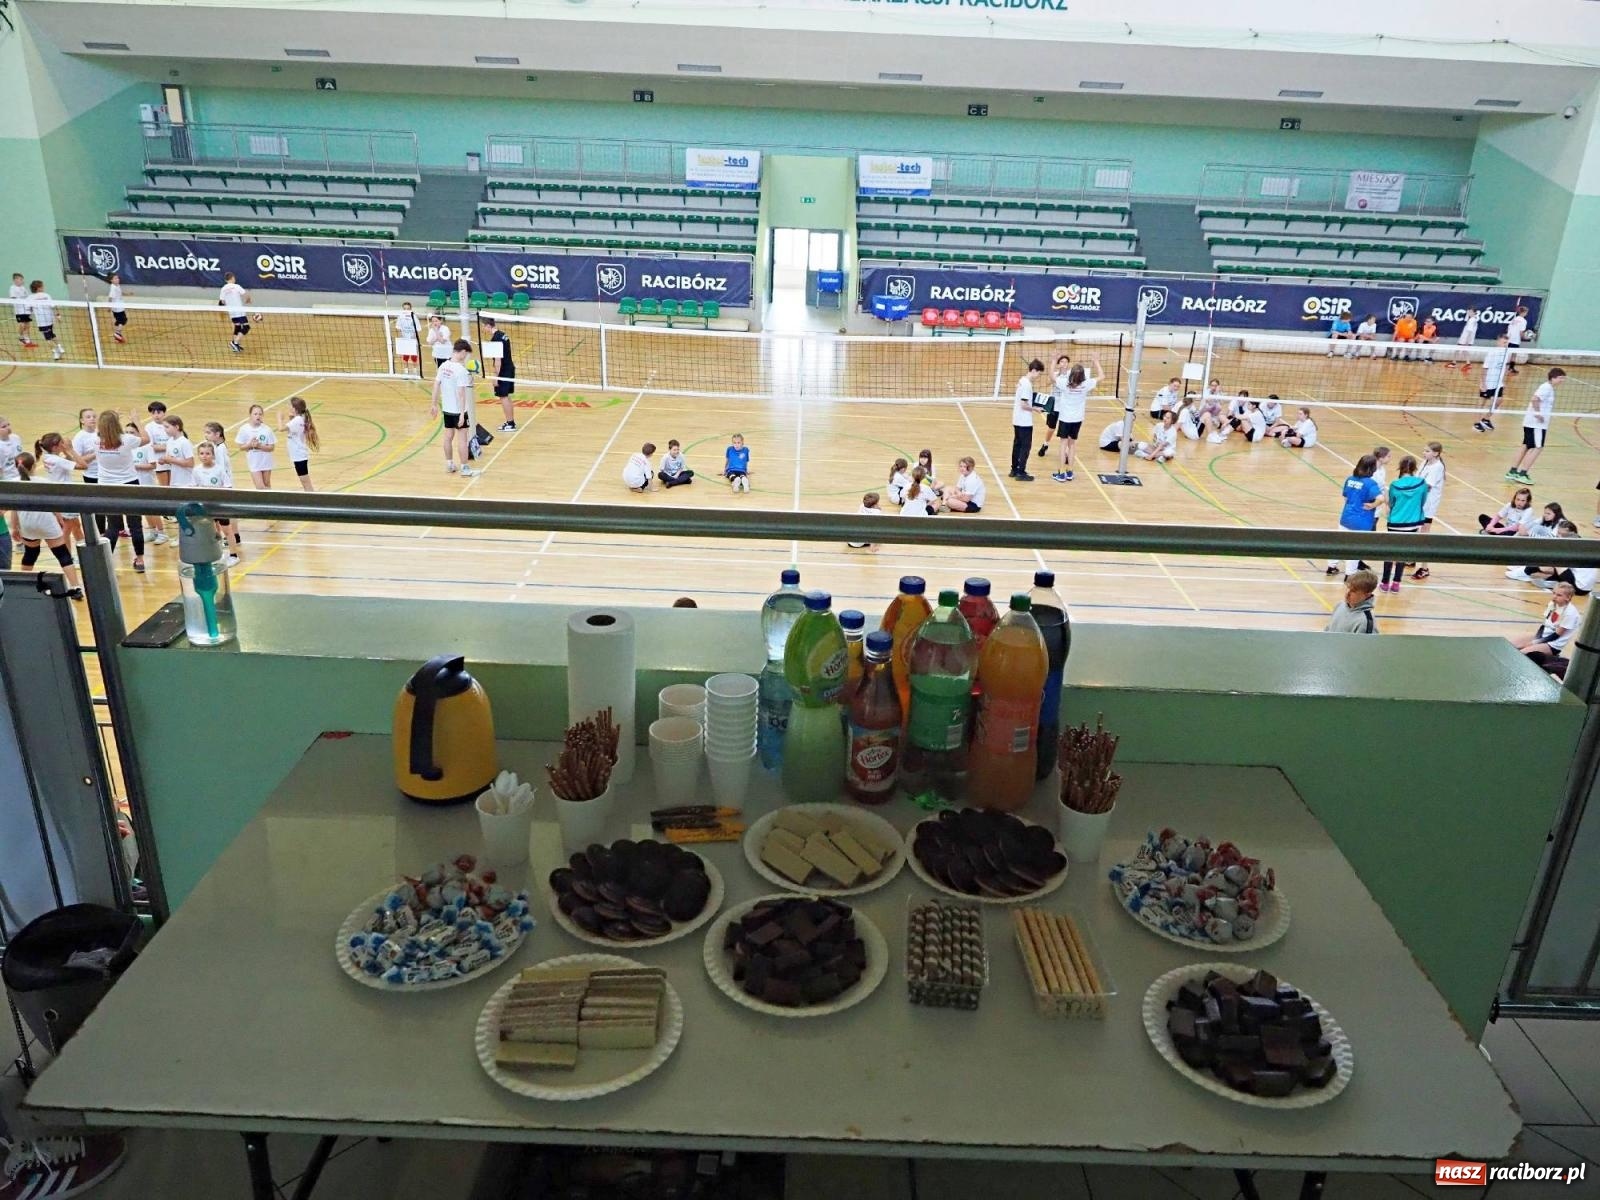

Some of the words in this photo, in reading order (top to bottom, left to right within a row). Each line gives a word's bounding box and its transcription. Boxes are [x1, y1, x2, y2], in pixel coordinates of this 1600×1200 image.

[970, 107, 978, 115] C
[1282, 121, 1292, 129] D
[134, 252, 220, 272] RACIBÓRZ
[256, 254, 307, 274] OSiR
[387, 262, 474, 281] RACIBÓRZ
[510, 264, 560, 283] OSiR
[641, 272, 727, 291] RACIBÓRZ
[930, 284, 1016, 303] RACIBÓRZ
[1181, 294, 1267, 313] RACIBÓRZ
